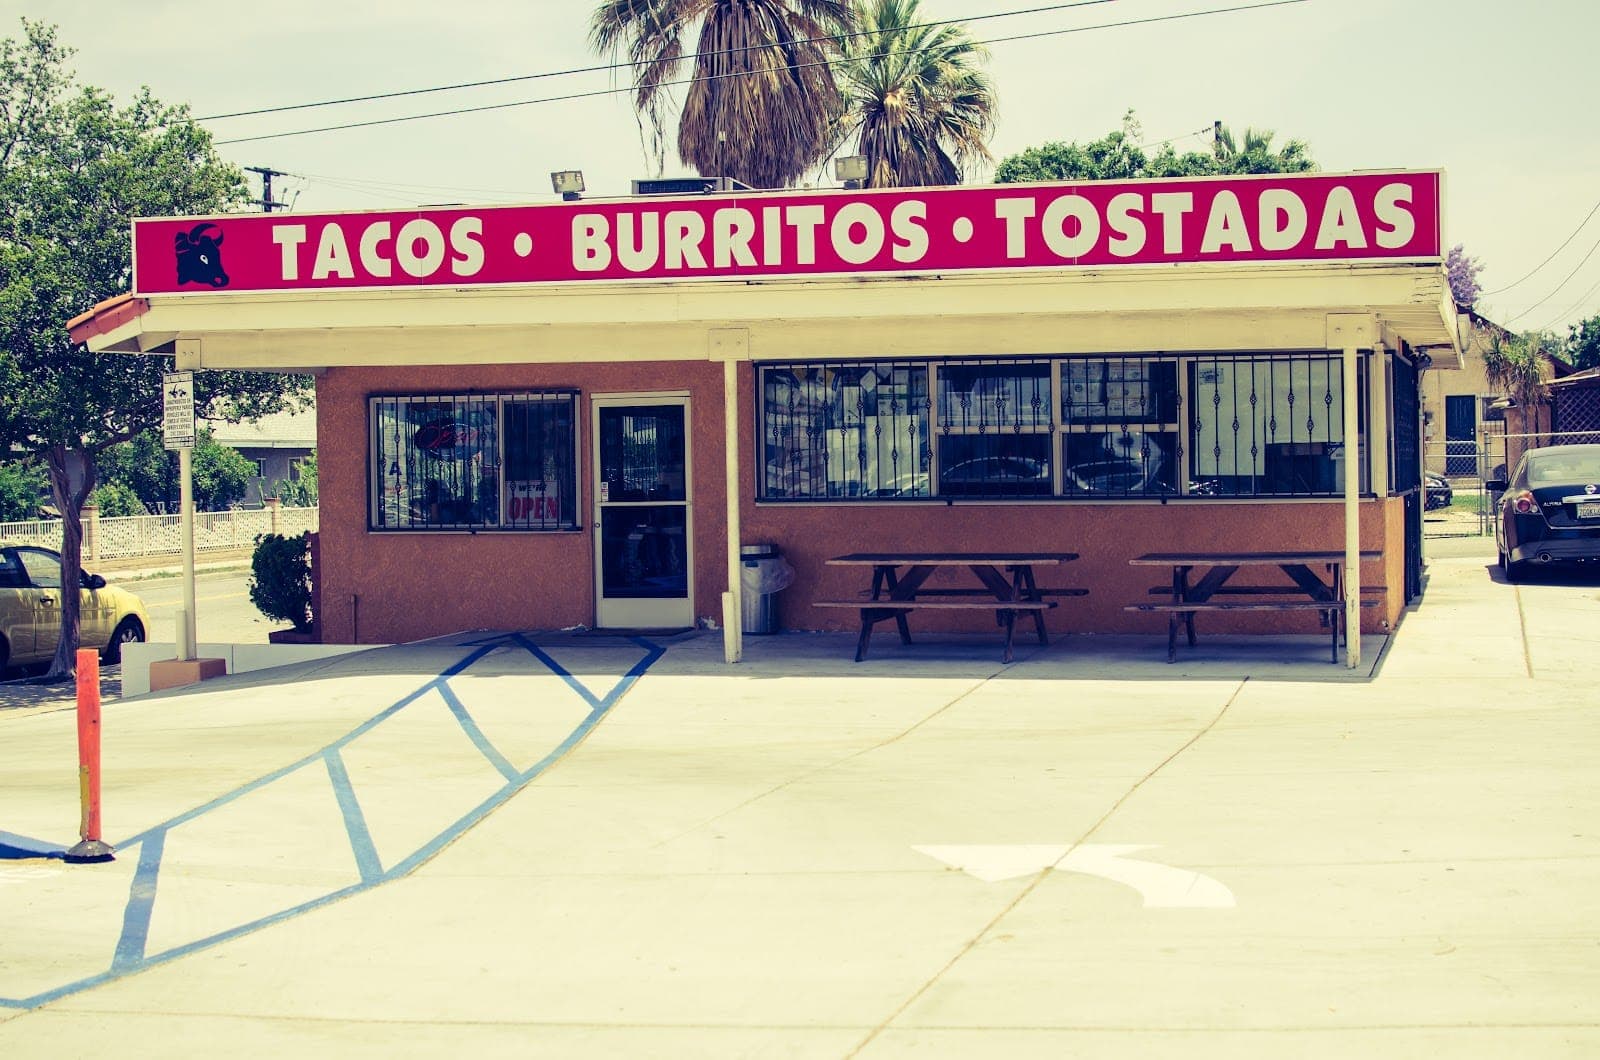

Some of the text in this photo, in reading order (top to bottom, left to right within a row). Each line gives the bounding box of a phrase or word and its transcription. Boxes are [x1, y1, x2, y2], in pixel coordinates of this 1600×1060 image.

[273, 183, 1415, 281] TACOS BURRITOS TOSTADAS
[509, 497, 559, 520] OPEN
